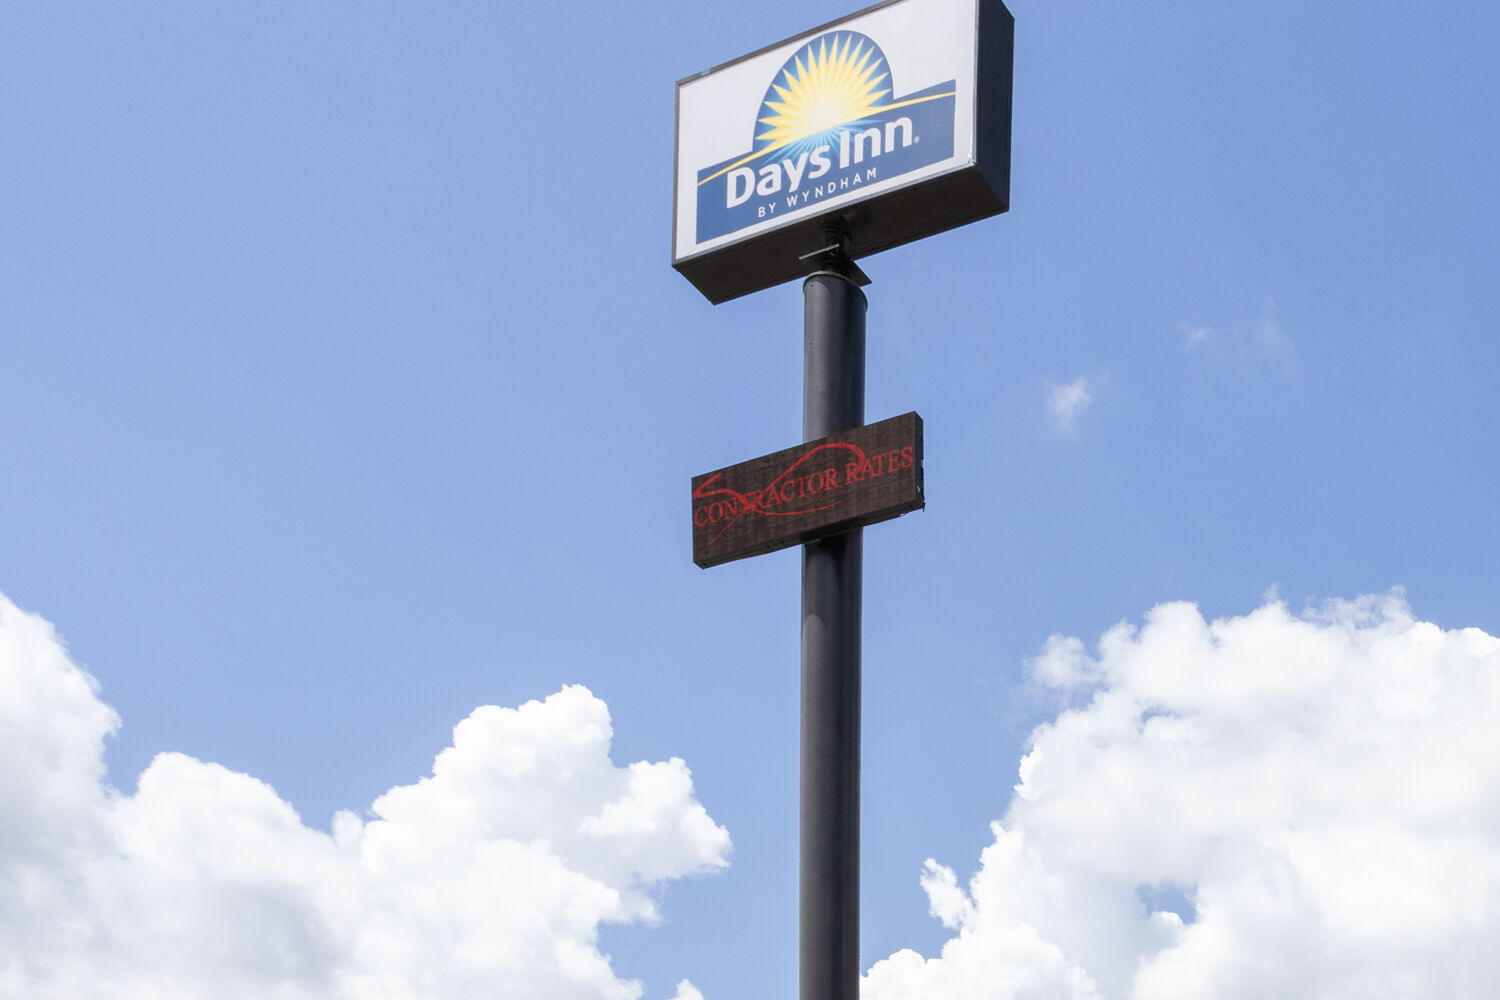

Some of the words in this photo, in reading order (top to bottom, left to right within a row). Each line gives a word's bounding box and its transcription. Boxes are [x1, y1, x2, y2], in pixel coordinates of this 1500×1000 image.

[727, 144, 832, 209] Days
[839, 116, 914, 169] Inn
[757, 202, 777, 219] BY
[786, 167, 878, 208] WYNDHAM
[694, 468, 840, 528] CONTRACTOR
[845, 446, 914, 486] RATES
